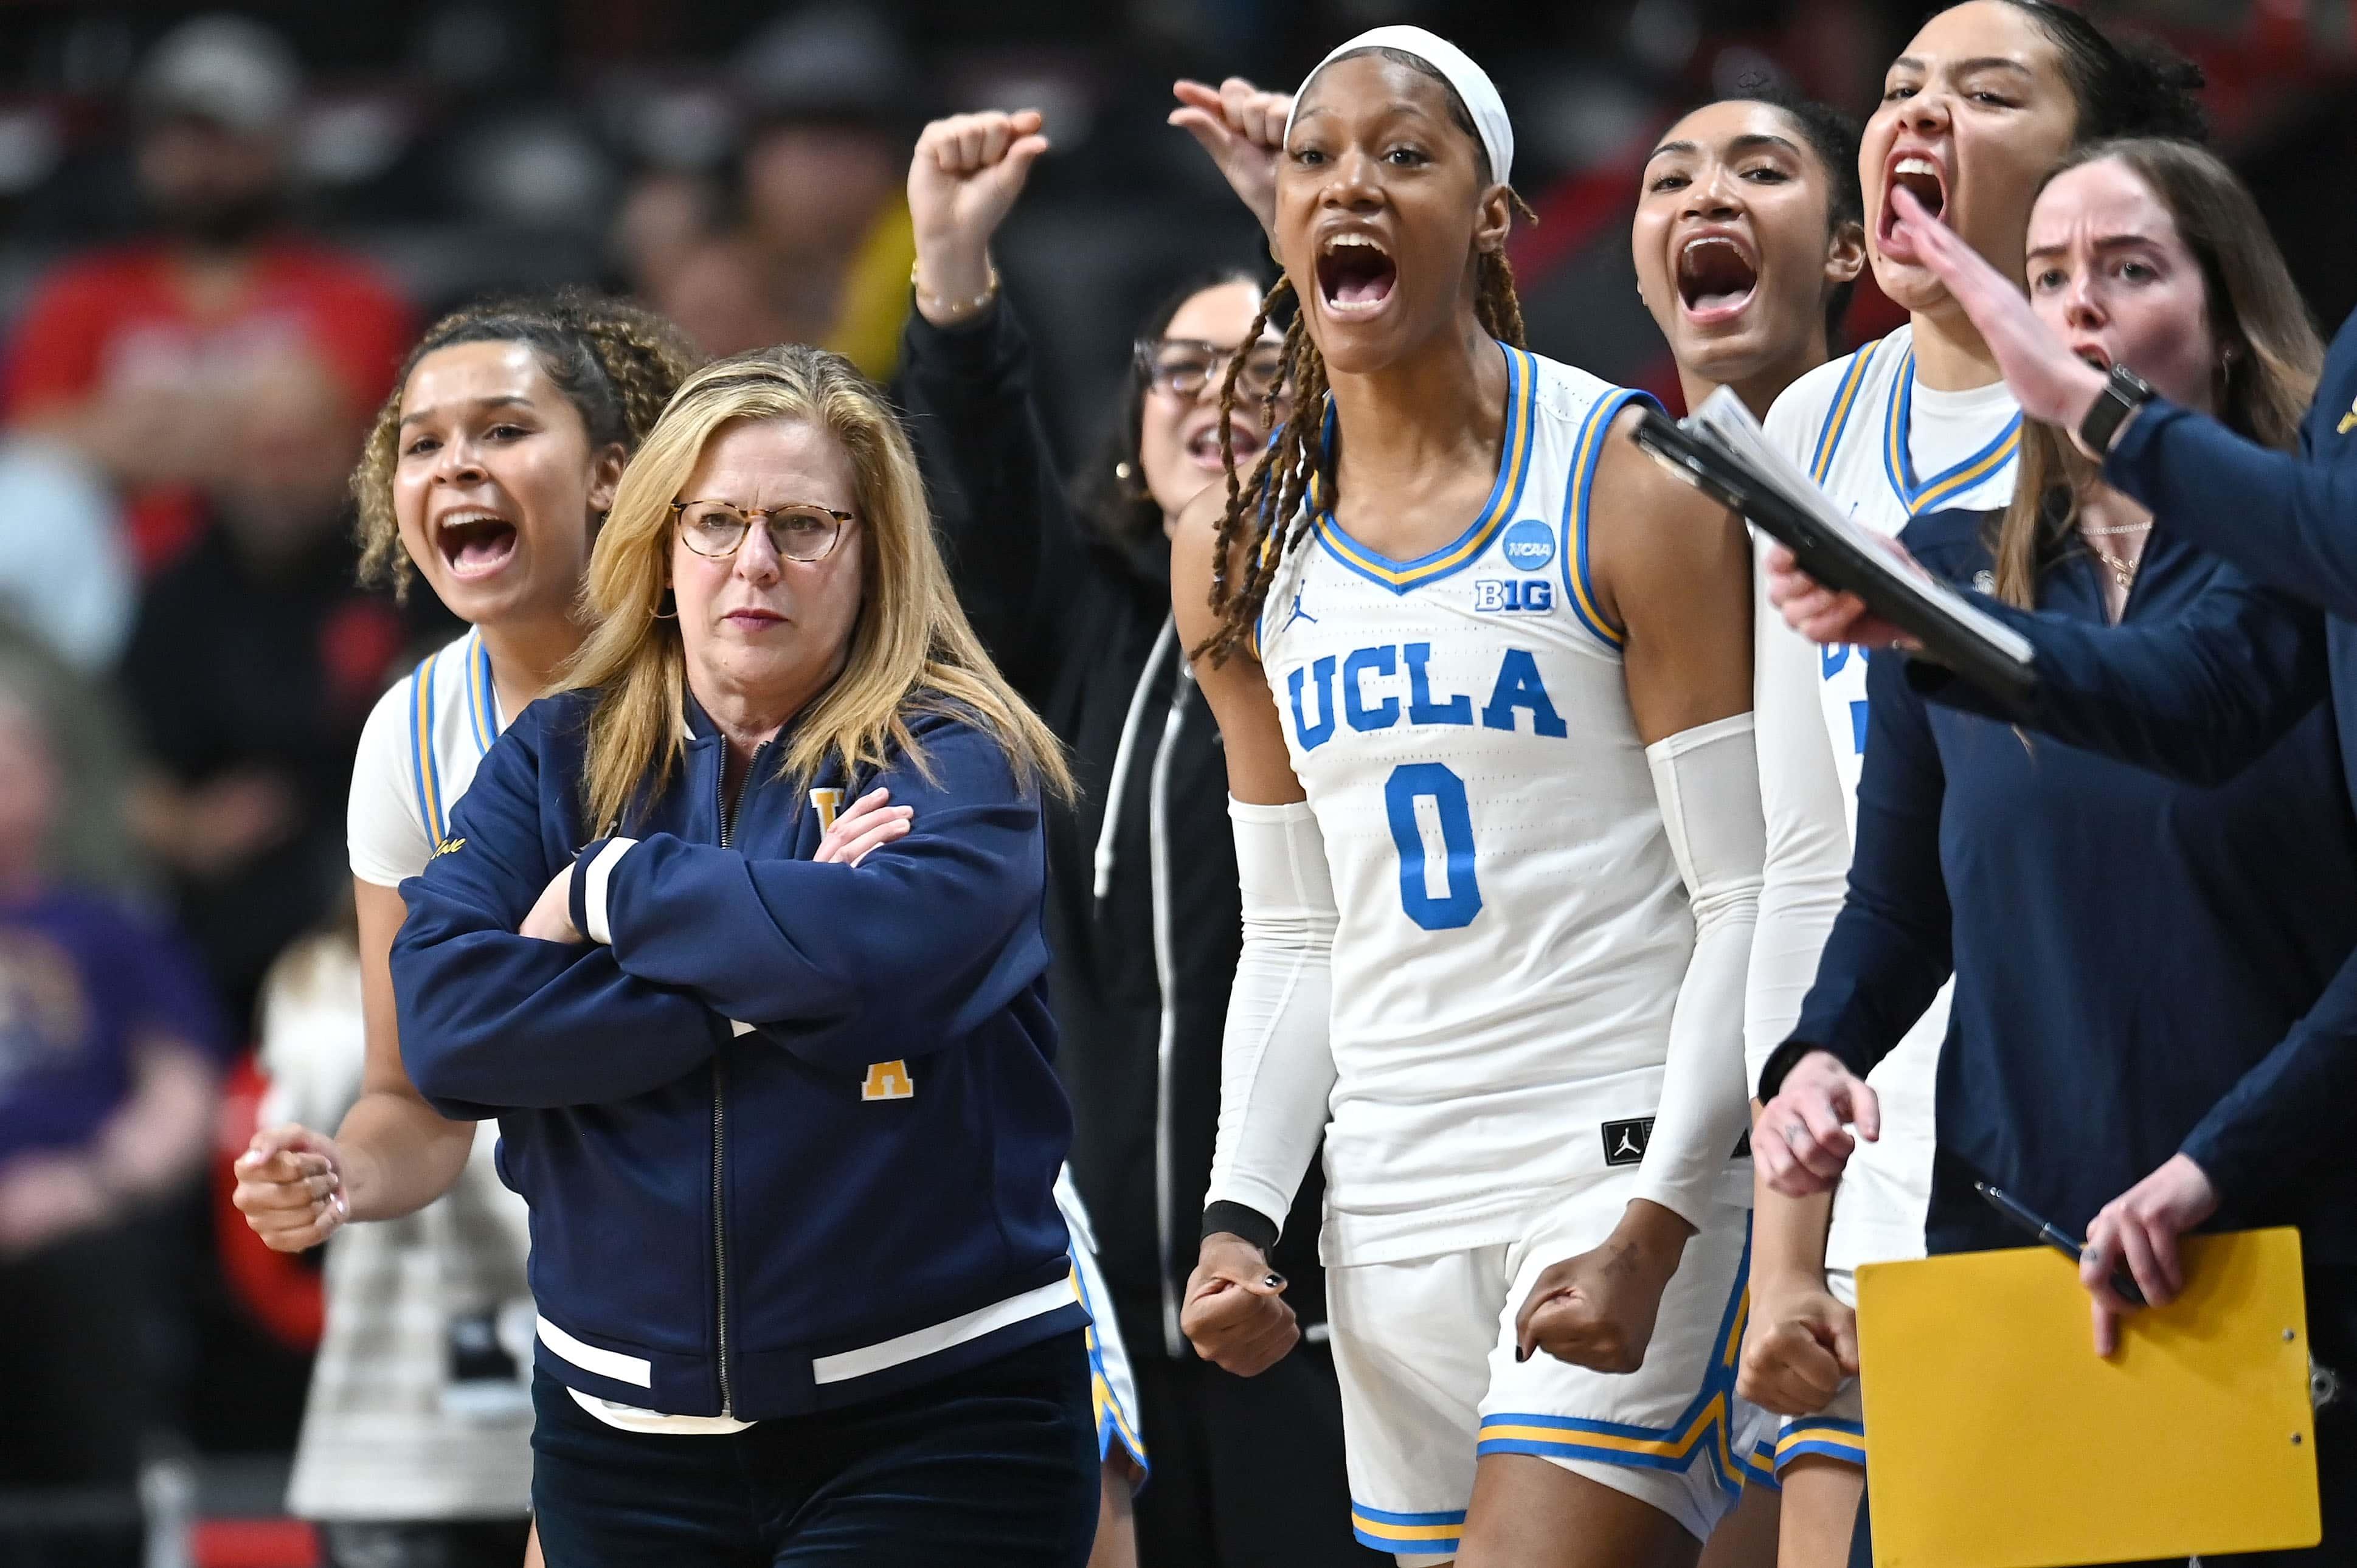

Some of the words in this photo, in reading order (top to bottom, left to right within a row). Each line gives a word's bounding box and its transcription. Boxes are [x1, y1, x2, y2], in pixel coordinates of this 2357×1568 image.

[1509, 542, 1550, 556] NCAA
[1288, 642, 1567, 751] UCLA
[1385, 762, 1482, 930] 0
